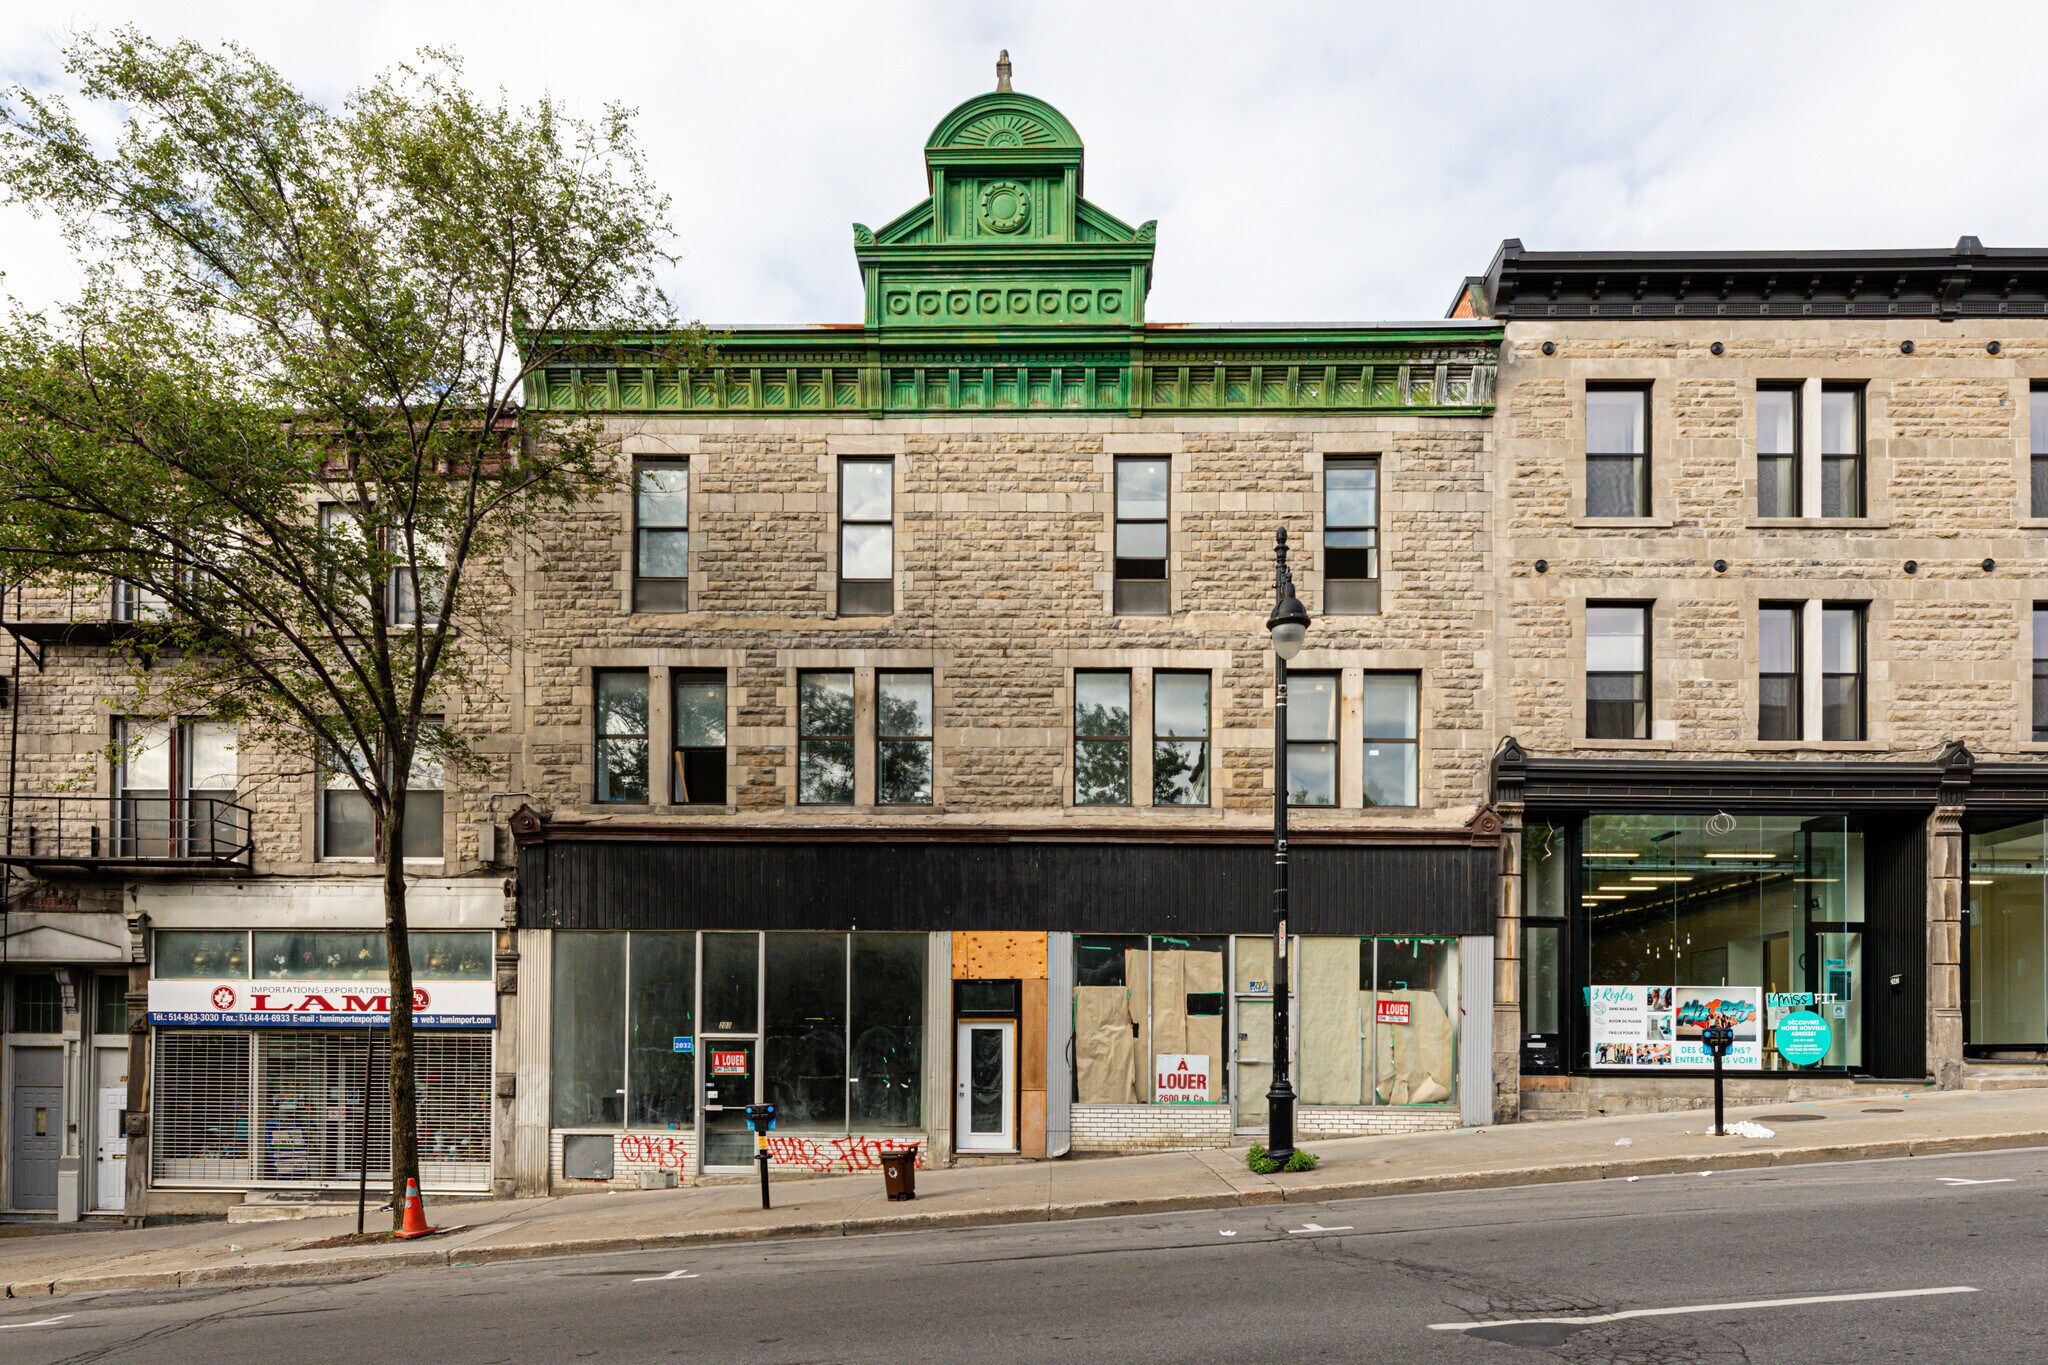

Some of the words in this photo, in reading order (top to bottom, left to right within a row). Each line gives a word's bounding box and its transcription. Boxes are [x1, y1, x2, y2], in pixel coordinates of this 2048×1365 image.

[251, 986, 391, 994] IMPORTATIONS-EXPORTATIONS
[1592, 988, 1600, 1000] 3
[250, 995, 391, 1011] LAM
[1814, 994, 1837, 1004] FIT
[1378, 1003, 1383, 1014] A
[1386, 1004, 1408, 1015] LOUER
[168, 1013, 219, 1022] 514-843-3030
[239, 1014, 290, 1023] 514-844-6933
[440, 1016, 491, 1026] lamimport.com
[1681, 1046, 1696, 1054] DES
[715, 1055, 720, 1065] A
[722, 1055, 744, 1065] LOUER
[1177, 1057, 1188, 1071] À
[1675, 1056, 1704, 1064] ENTREZ
[1158, 1073, 1206, 1089] LOUER
[1159, 1094, 1178, 1102] 2600
